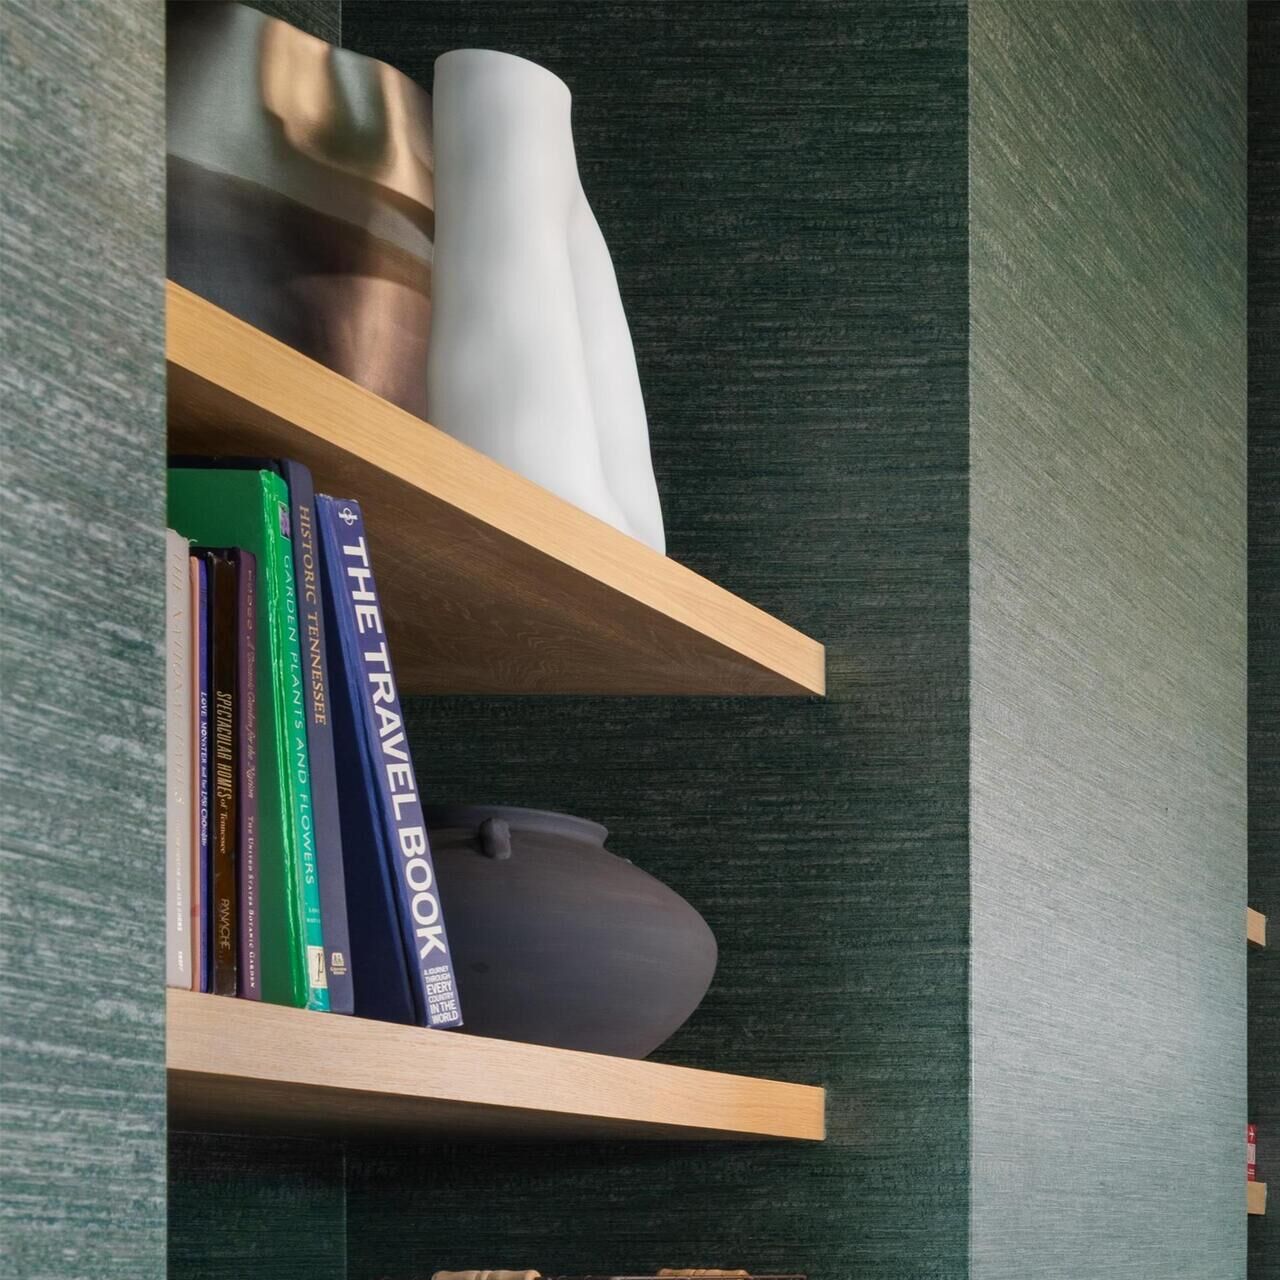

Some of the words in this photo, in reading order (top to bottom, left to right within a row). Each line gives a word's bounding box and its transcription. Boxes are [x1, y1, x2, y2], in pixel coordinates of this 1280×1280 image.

[299, 505, 317, 604] HISTORIC
[283, 555, 296, 641] GARDEN
[290, 651, 305, 730] PLANTS
[307, 612, 328, 725] TENNESSEE
[200, 691, 208, 716] LOVE
[216, 691, 233, 760] SPECTACULAR
[295, 737, 308, 783] AND
[343, 536, 383, 634] THE
[364, 642, 416, 820] TRAVEL
[398, 826, 448, 960] BOOK
[217, 762, 233, 798] HOMES
[219, 812, 229, 855] Tennessee
[300, 793, 315, 886] FLOWERS
[221, 898, 231, 951] PANACHE
[426, 980, 453, 995] EVERY
[430, 1003, 440, 1014] IN
[440, 1000, 457, 1013] THE
[432, 1011, 458, 1024] WORLD
